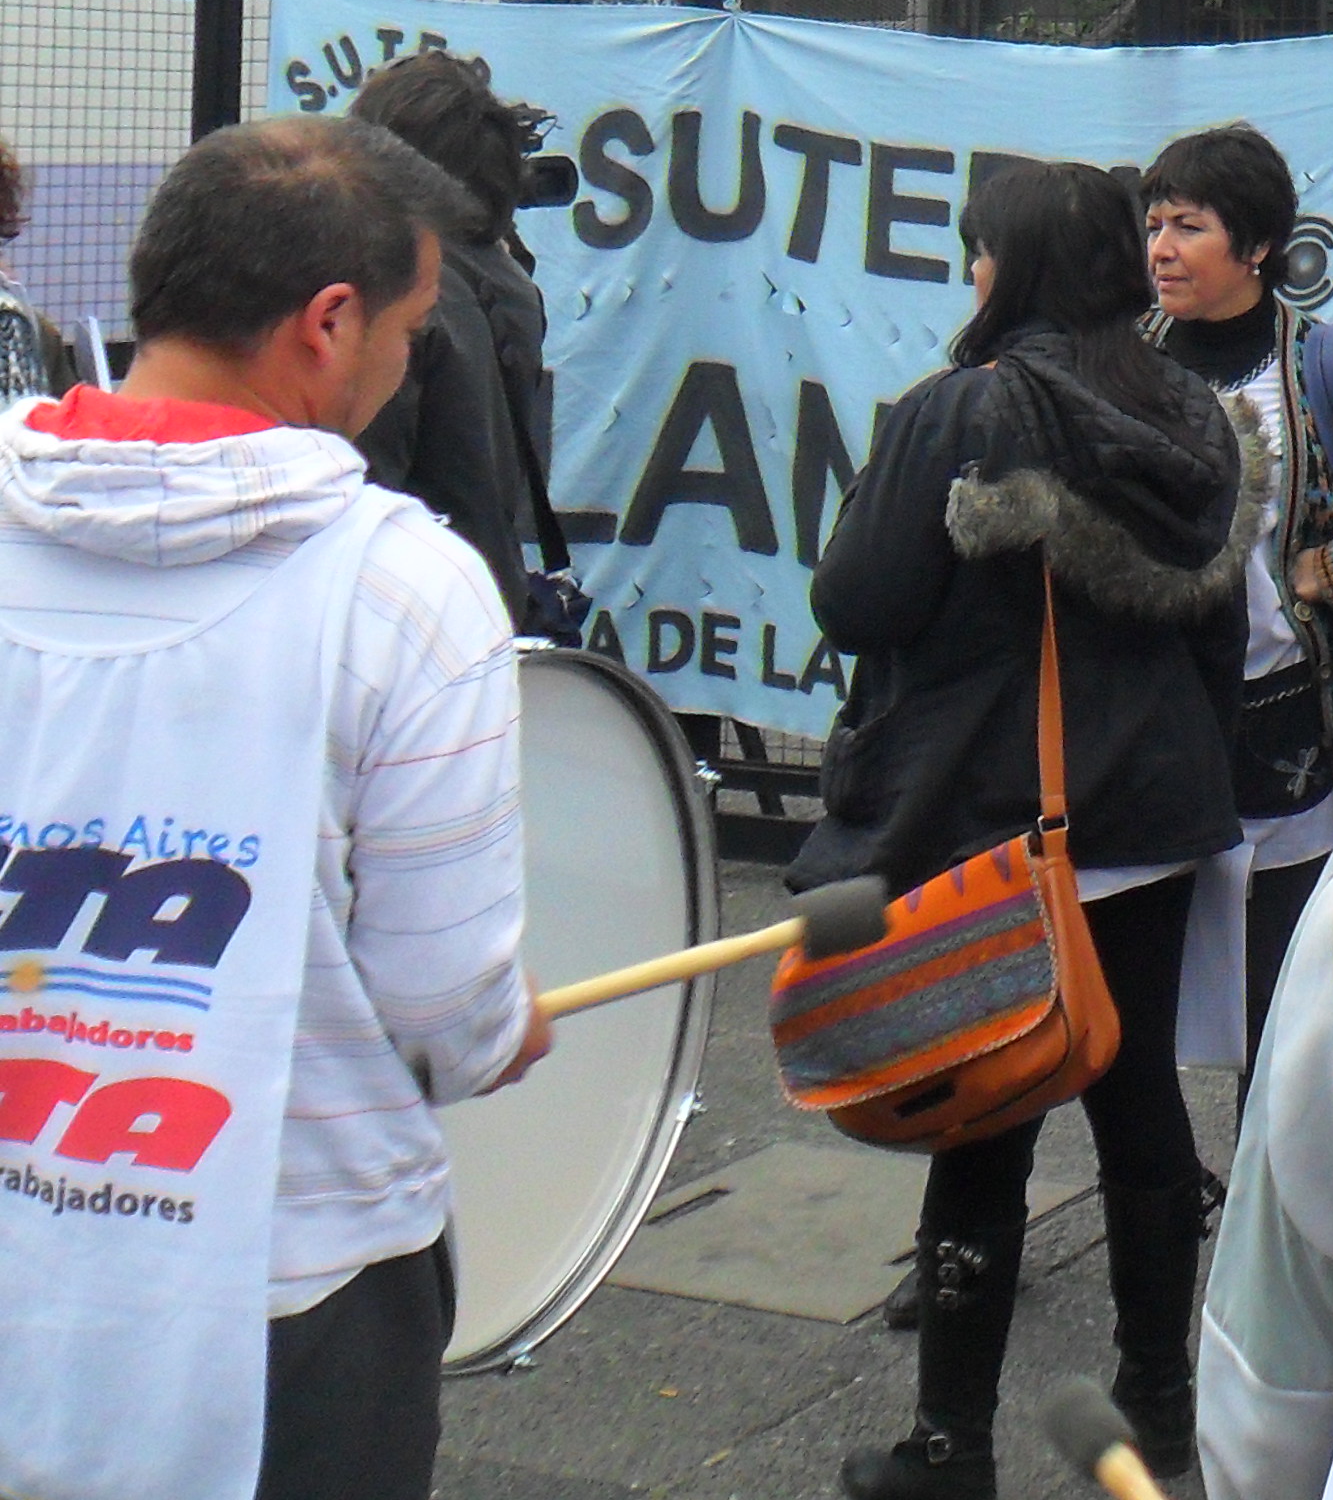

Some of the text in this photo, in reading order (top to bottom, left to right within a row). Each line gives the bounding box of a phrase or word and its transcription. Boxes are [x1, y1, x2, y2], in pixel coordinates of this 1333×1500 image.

[573, 107, 1141, 286] SUTE
[648, 607, 742, 681] DE
[761, 623, 848, 701] LA
[120, 814, 262, 868] Aires
[0, 835, 254, 970] TA
[0, 1057, 233, 1173] TA
